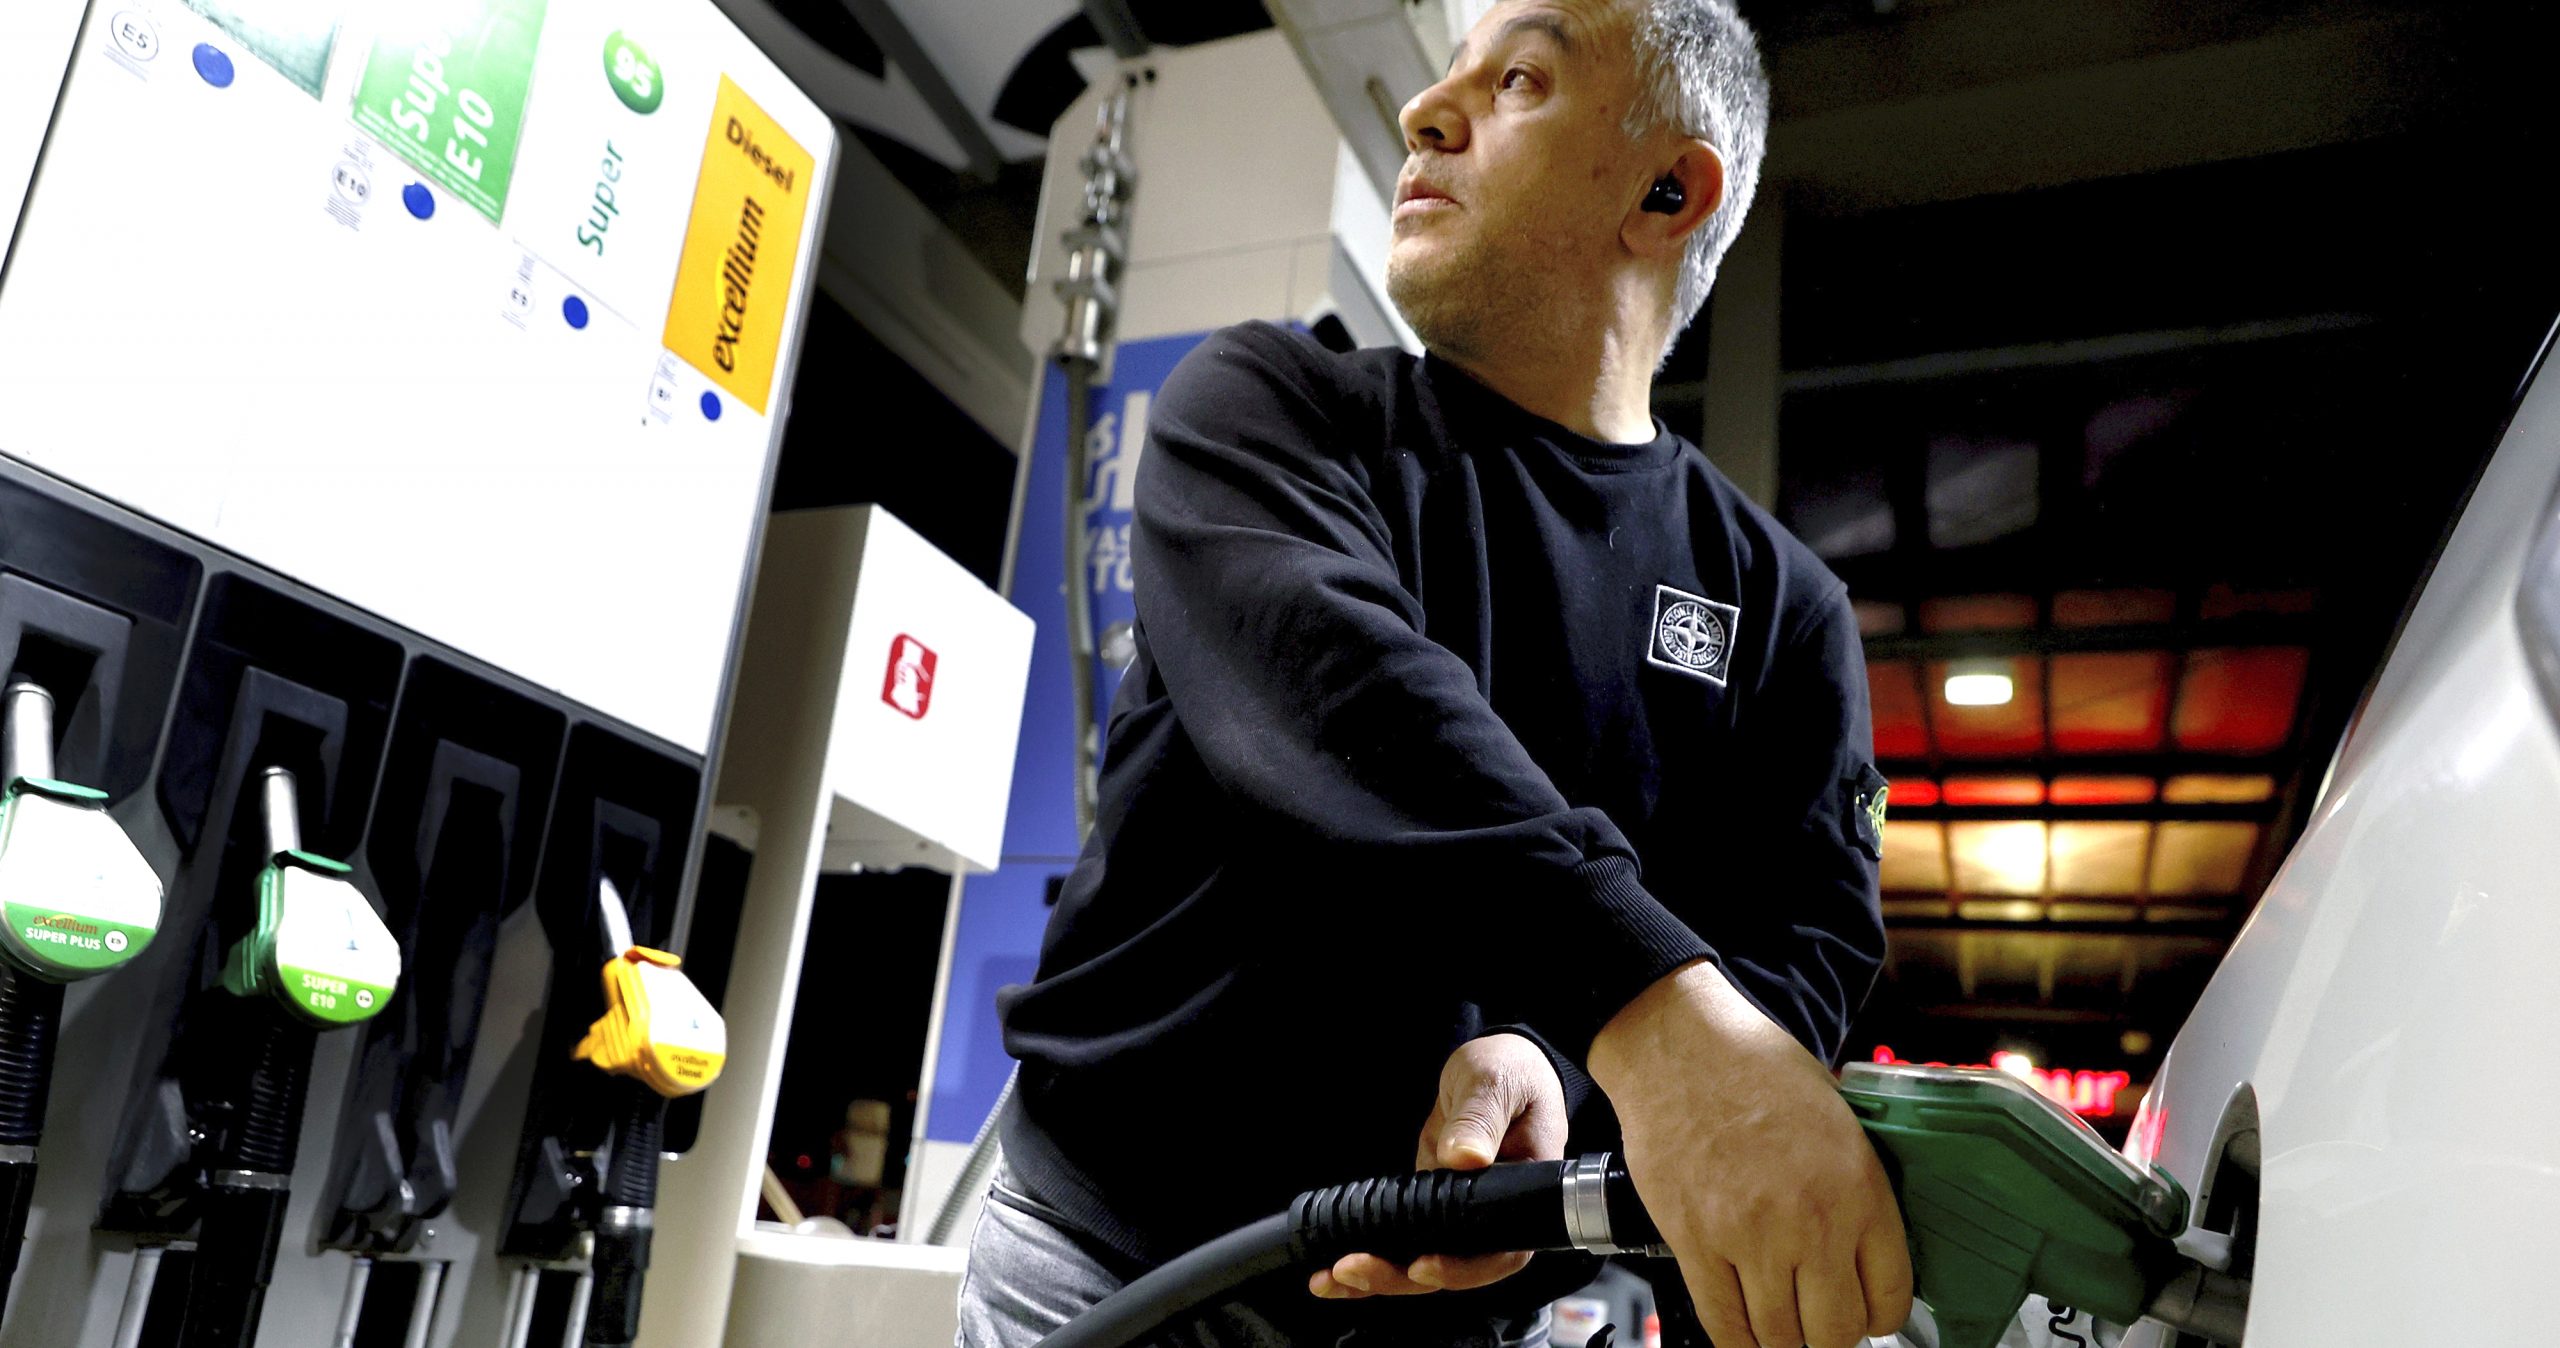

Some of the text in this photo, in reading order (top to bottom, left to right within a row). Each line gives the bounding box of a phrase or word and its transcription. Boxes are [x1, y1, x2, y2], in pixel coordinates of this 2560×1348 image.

[122, 22, 149, 49] E5
[391, 28, 452, 142] Supe
[613, 46, 654, 99] 95
[445, 87, 494, 182] E10
[726, 115, 794, 194] Diesel
[577, 139, 624, 256] Super
[712, 196, 766, 374] excellium
[25, 926, 101, 950] SUPER PLUS
[302, 973, 348, 997] SUPER
[310, 991, 336, 1010] E10
